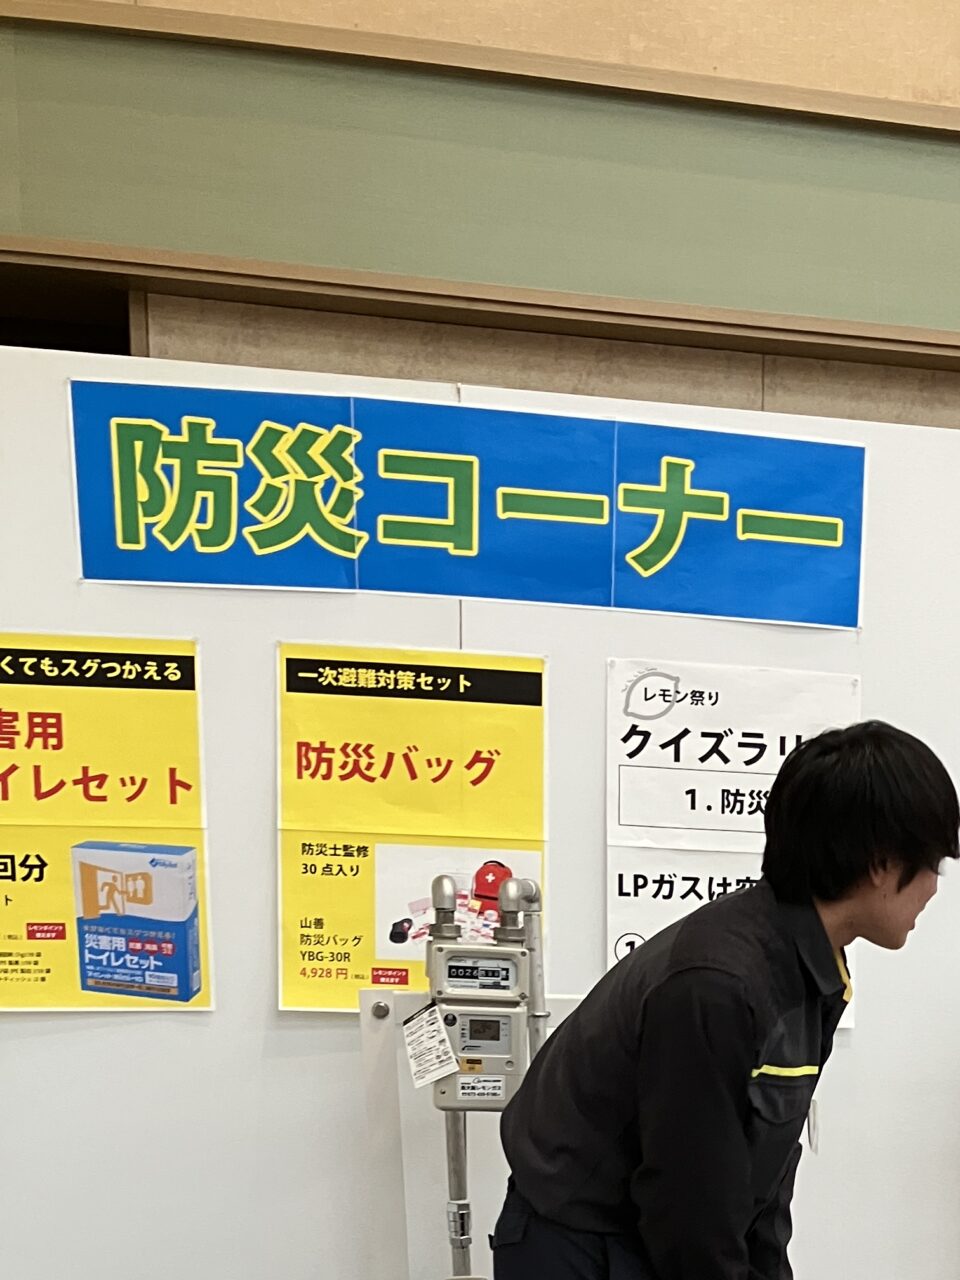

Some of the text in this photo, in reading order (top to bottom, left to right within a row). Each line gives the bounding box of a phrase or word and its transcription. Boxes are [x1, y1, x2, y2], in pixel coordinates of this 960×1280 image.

[109, 416, 843, 577] 防災コーナー
[0, 656, 182, 681] くてもスグつかえる
[297, 667, 472, 693] 一次避難対策セット
[643, 687, 720, 706] レモン祭り
[296, 741, 501, 786] 防災バッグ
[301, 843, 370, 858] 防災士監修
[299, 918, 325, 929] 山善
[300, 934, 364, 947] 防災バッグ
[84, 949, 163, 970] トイレセット
[300, 950, 351, 962] YBG-30R
